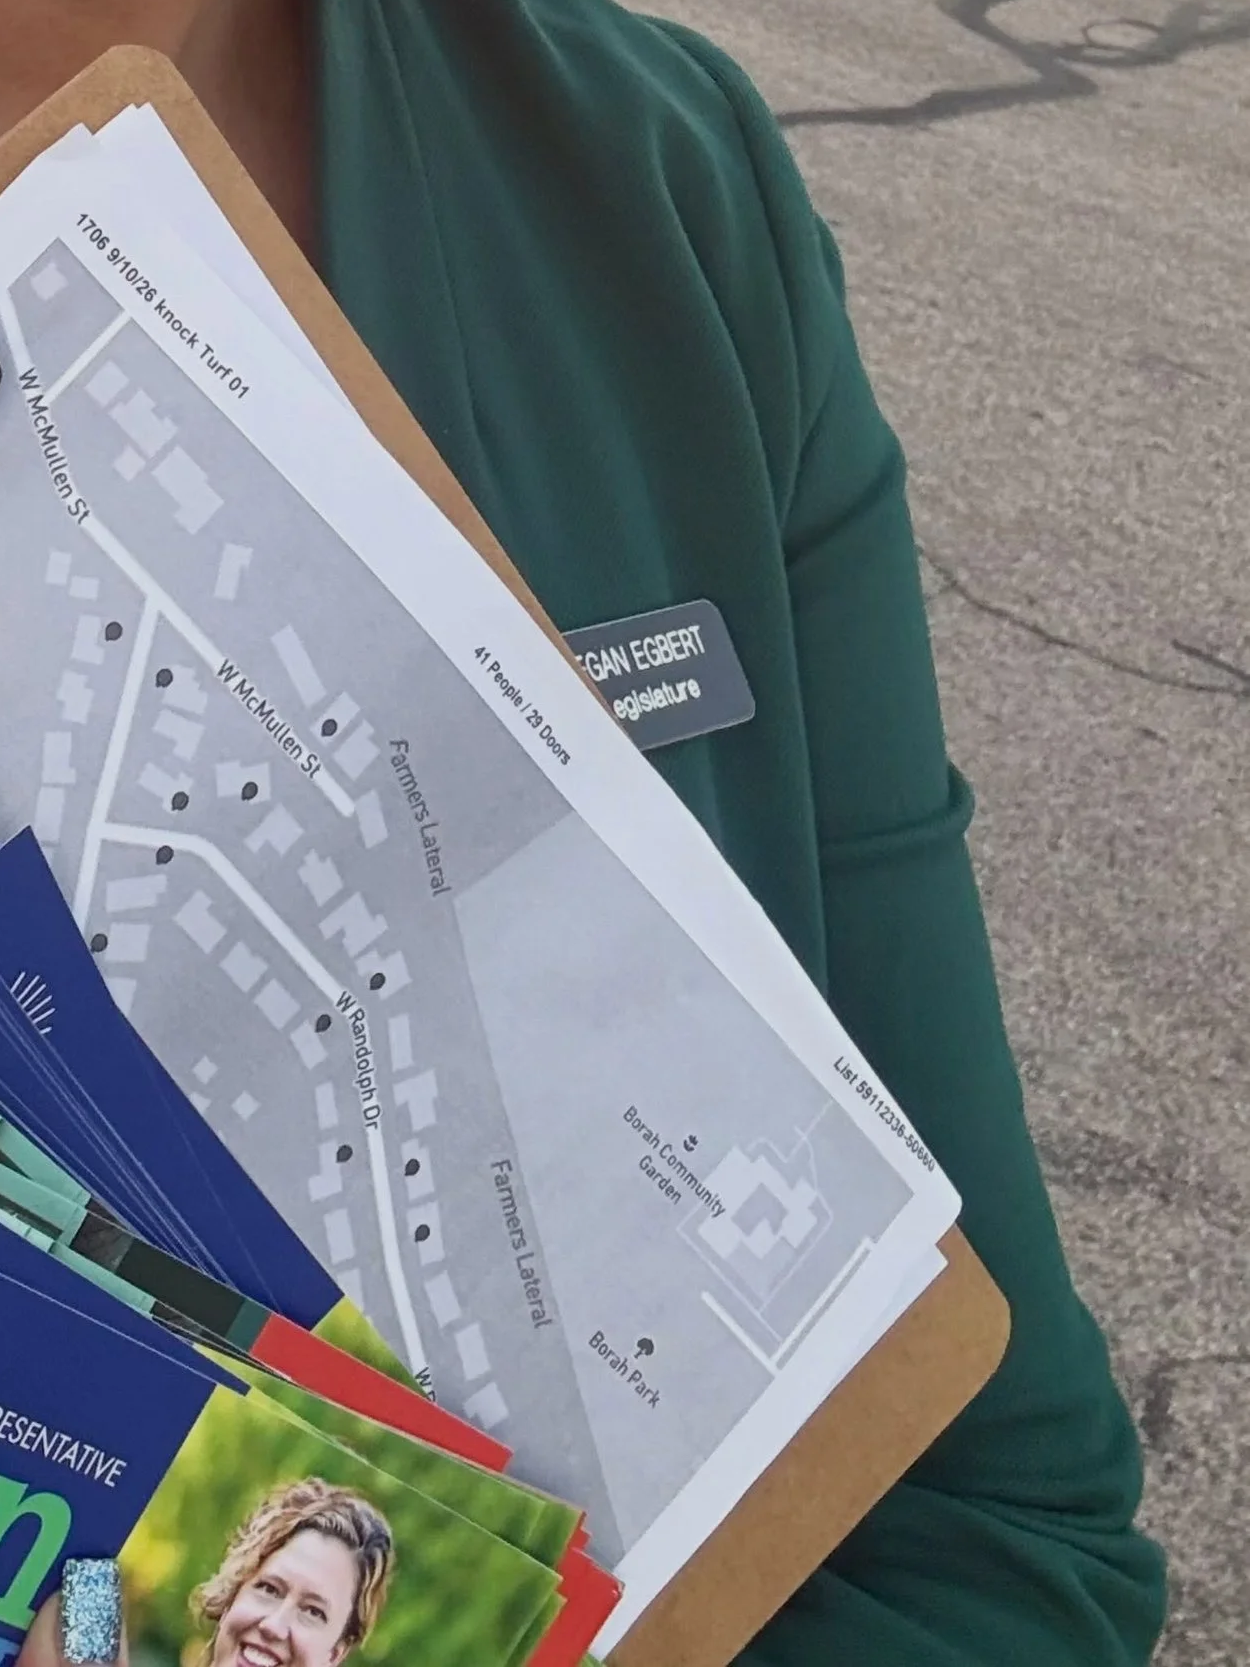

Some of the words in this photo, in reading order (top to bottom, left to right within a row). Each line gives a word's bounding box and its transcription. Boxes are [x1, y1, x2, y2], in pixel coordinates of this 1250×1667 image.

[76, 213, 110, 251] 1706
[106, 247, 157, 302] 9/10/26
[154, 298, 199, 349] knock
[199, 343, 233, 380] Turf
[228, 376, 251, 399] 01
[18, 367, 41, 392] W
[27, 394, 75, 501] McMullen
[67, 497, 92, 525] St
[629, 625, 705, 671] EGBERT
[216, 658, 240, 685] W
[232, 677, 303, 761] McMullen
[299, 753, 322, 779] St
[473, 645, 490, 667] 41
[486, 662, 524, 709] People
[525, 708, 544, 729] 29
[538, 724, 573, 767] Doors
[613, 678, 702, 721] egislature
[388, 738, 430, 823] Farmers
[419, 821, 453, 897] Lateral
[335, 989, 357, 1014] W
[348, 1008, 379, 1102] Randolph
[833, 1055, 859, 1085] List
[361, 1104, 382, 1131] Dr
[622, 1105, 660, 1150] Borah
[658, 1142, 728, 1219] Community
[638, 1154, 683, 1206] Garden
[490, 1157, 527, 1252] Farmers
[515, 1253, 554, 1329] Lateral
[588, 1329, 628, 1379] Borah
[627, 1369, 661, 1409] Park
